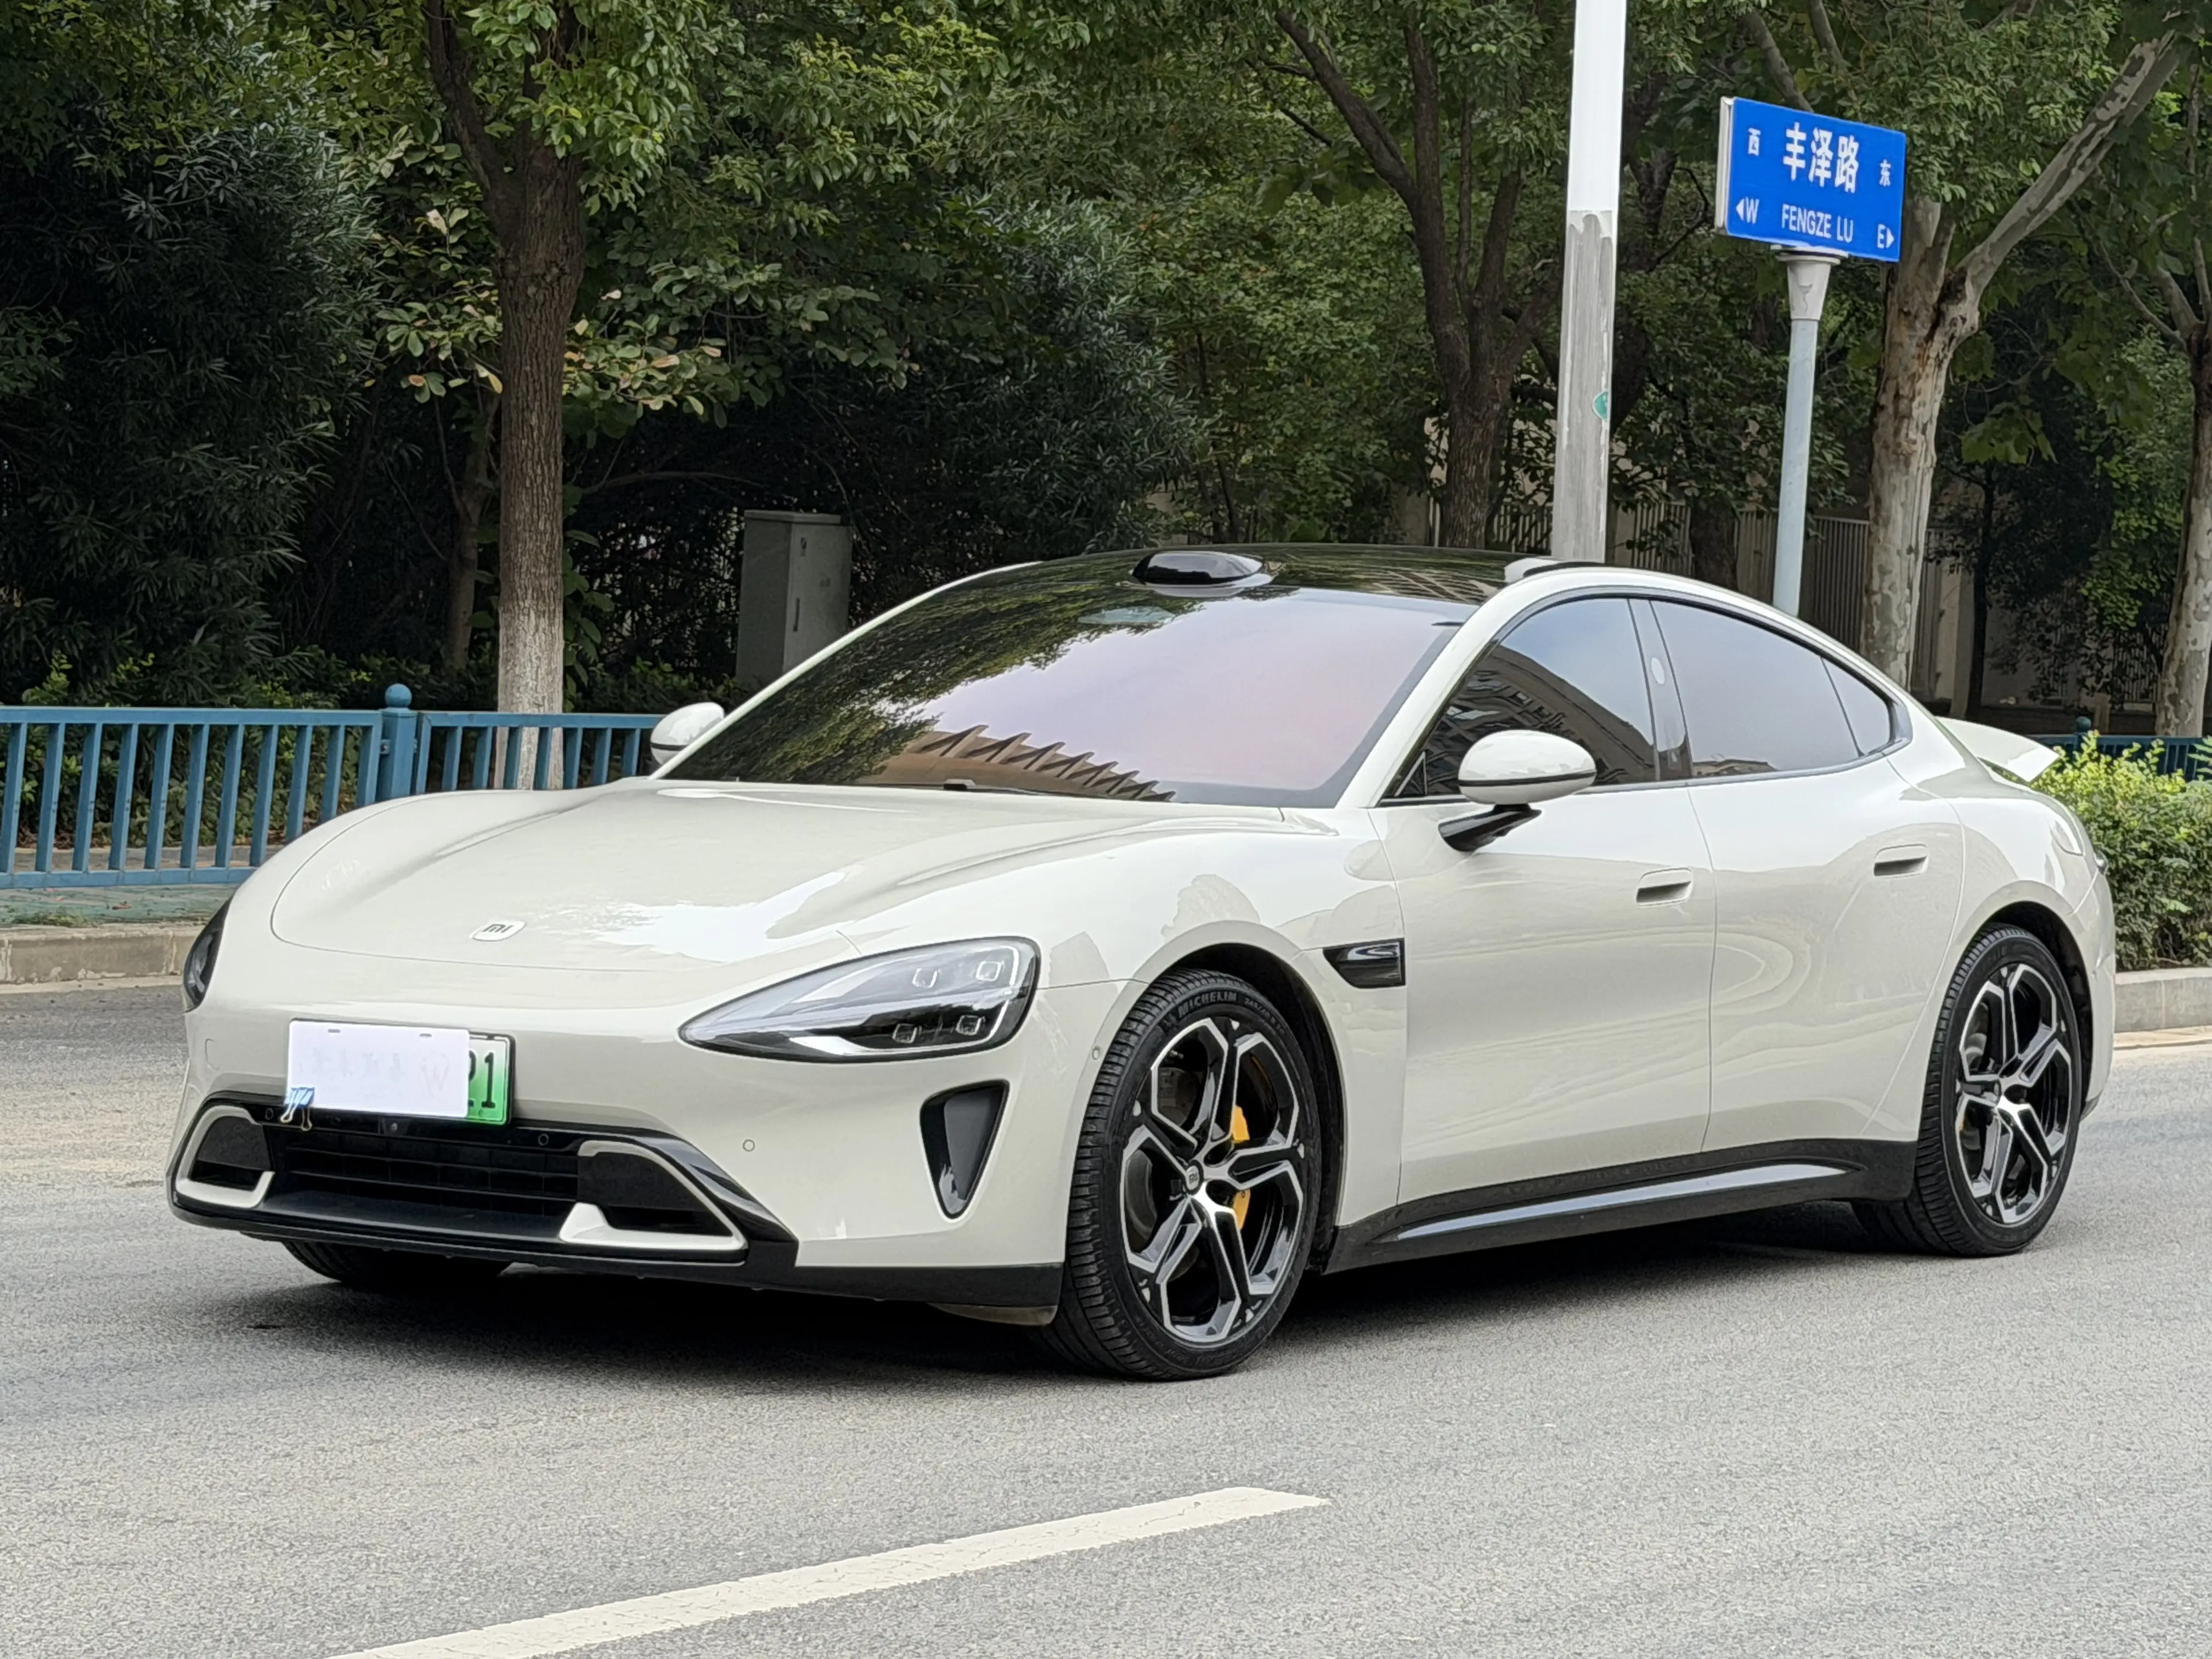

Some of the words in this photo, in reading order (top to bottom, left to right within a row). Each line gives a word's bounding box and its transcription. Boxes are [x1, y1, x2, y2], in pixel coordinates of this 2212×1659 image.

[1748, 128, 1761, 156] 西
[1783, 122, 1859, 193] 丰泽路
[1879, 159, 1891, 187] 东
[1745, 197, 1760, 224] W
[1781, 204, 1832, 239] FENGZE
[1836, 216, 1854, 243] LU
[1877, 224, 1886, 249] E
[1178, 991, 1237, 1017] MICHELIN
